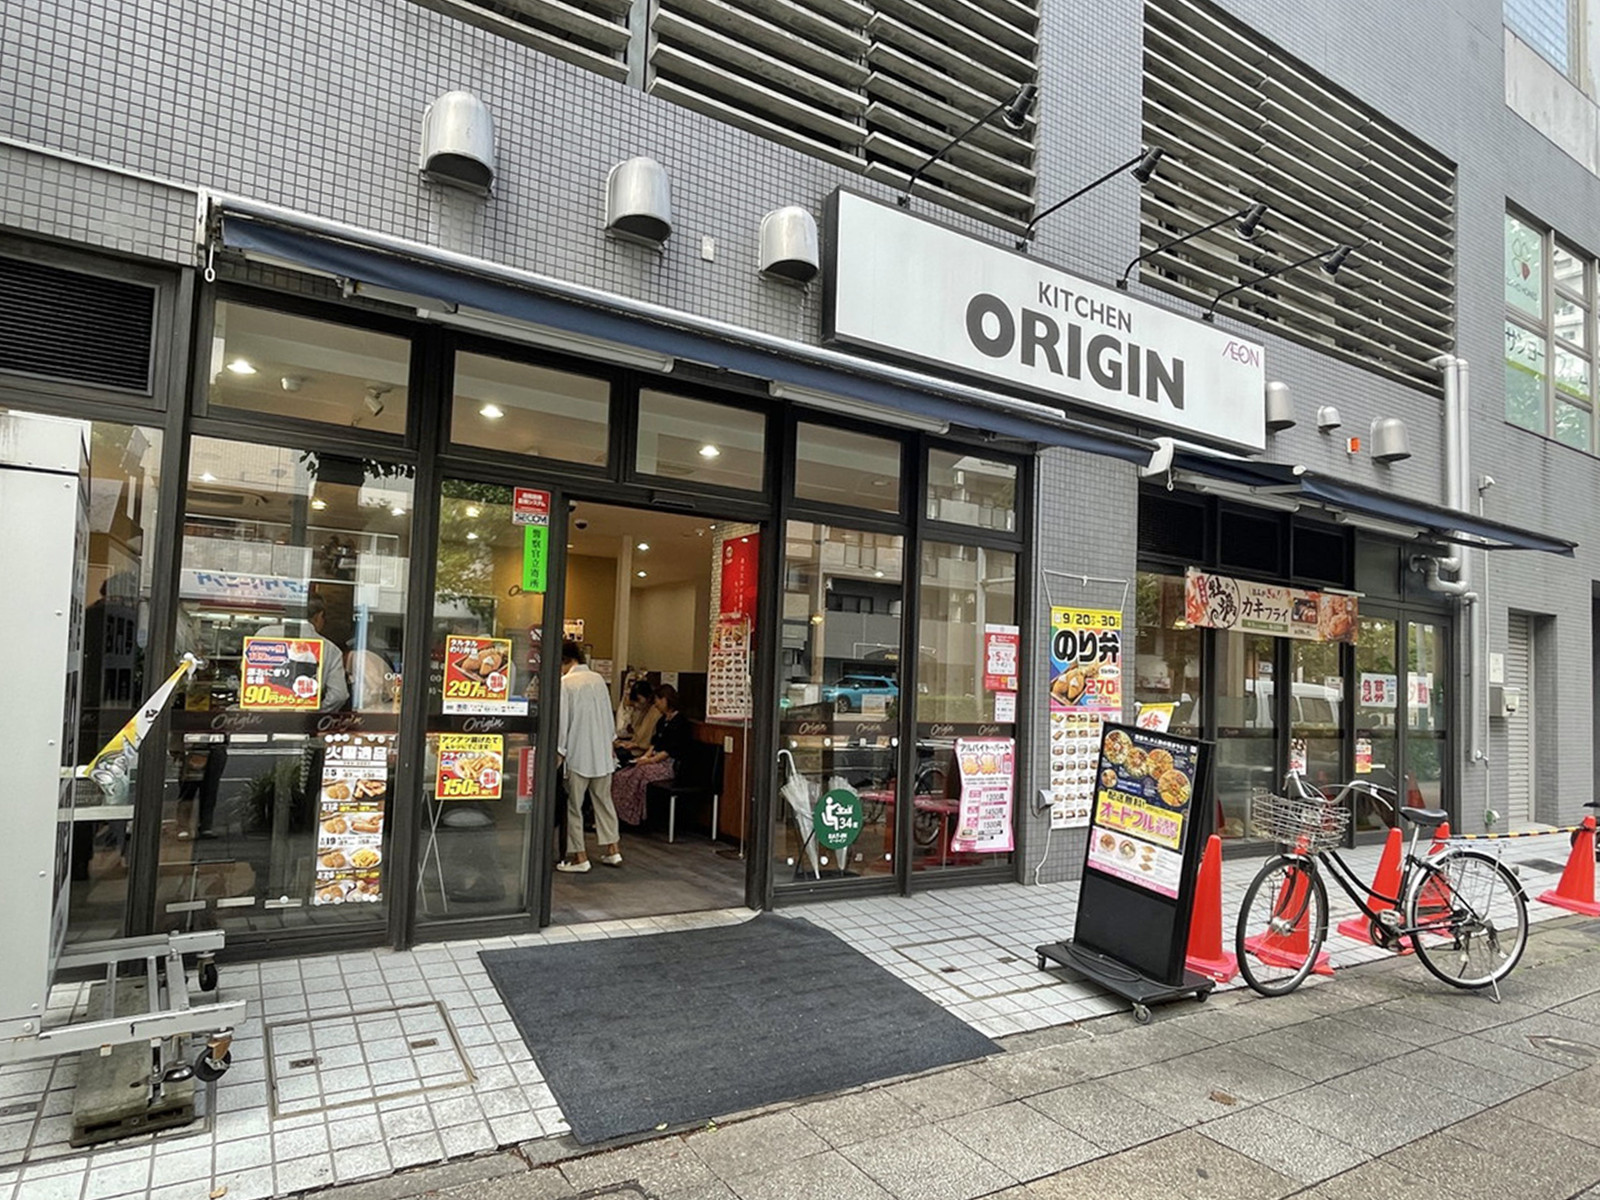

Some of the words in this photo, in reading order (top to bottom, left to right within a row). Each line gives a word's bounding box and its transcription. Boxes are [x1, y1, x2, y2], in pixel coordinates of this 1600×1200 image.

[1038, 281, 1132, 334] KITCHEN
[966, 293, 1184, 410] ORIGIN
[515, 513, 547, 524] SECOM
[529, 529, 541, 588] 警察官立寄所
[1241, 597, 1289, 623] カキフライ
[1053, 629, 1119, 663] のり弁
[447, 680, 486, 698] 297円
[1086, 680, 1115, 694] 270
[211, 714, 264, 731] Origin
[317, 715, 365, 731] Origin
[463, 717, 504, 732] Origin
[799, 721, 828, 736] Origin
[443, 779, 481, 796] 150円
